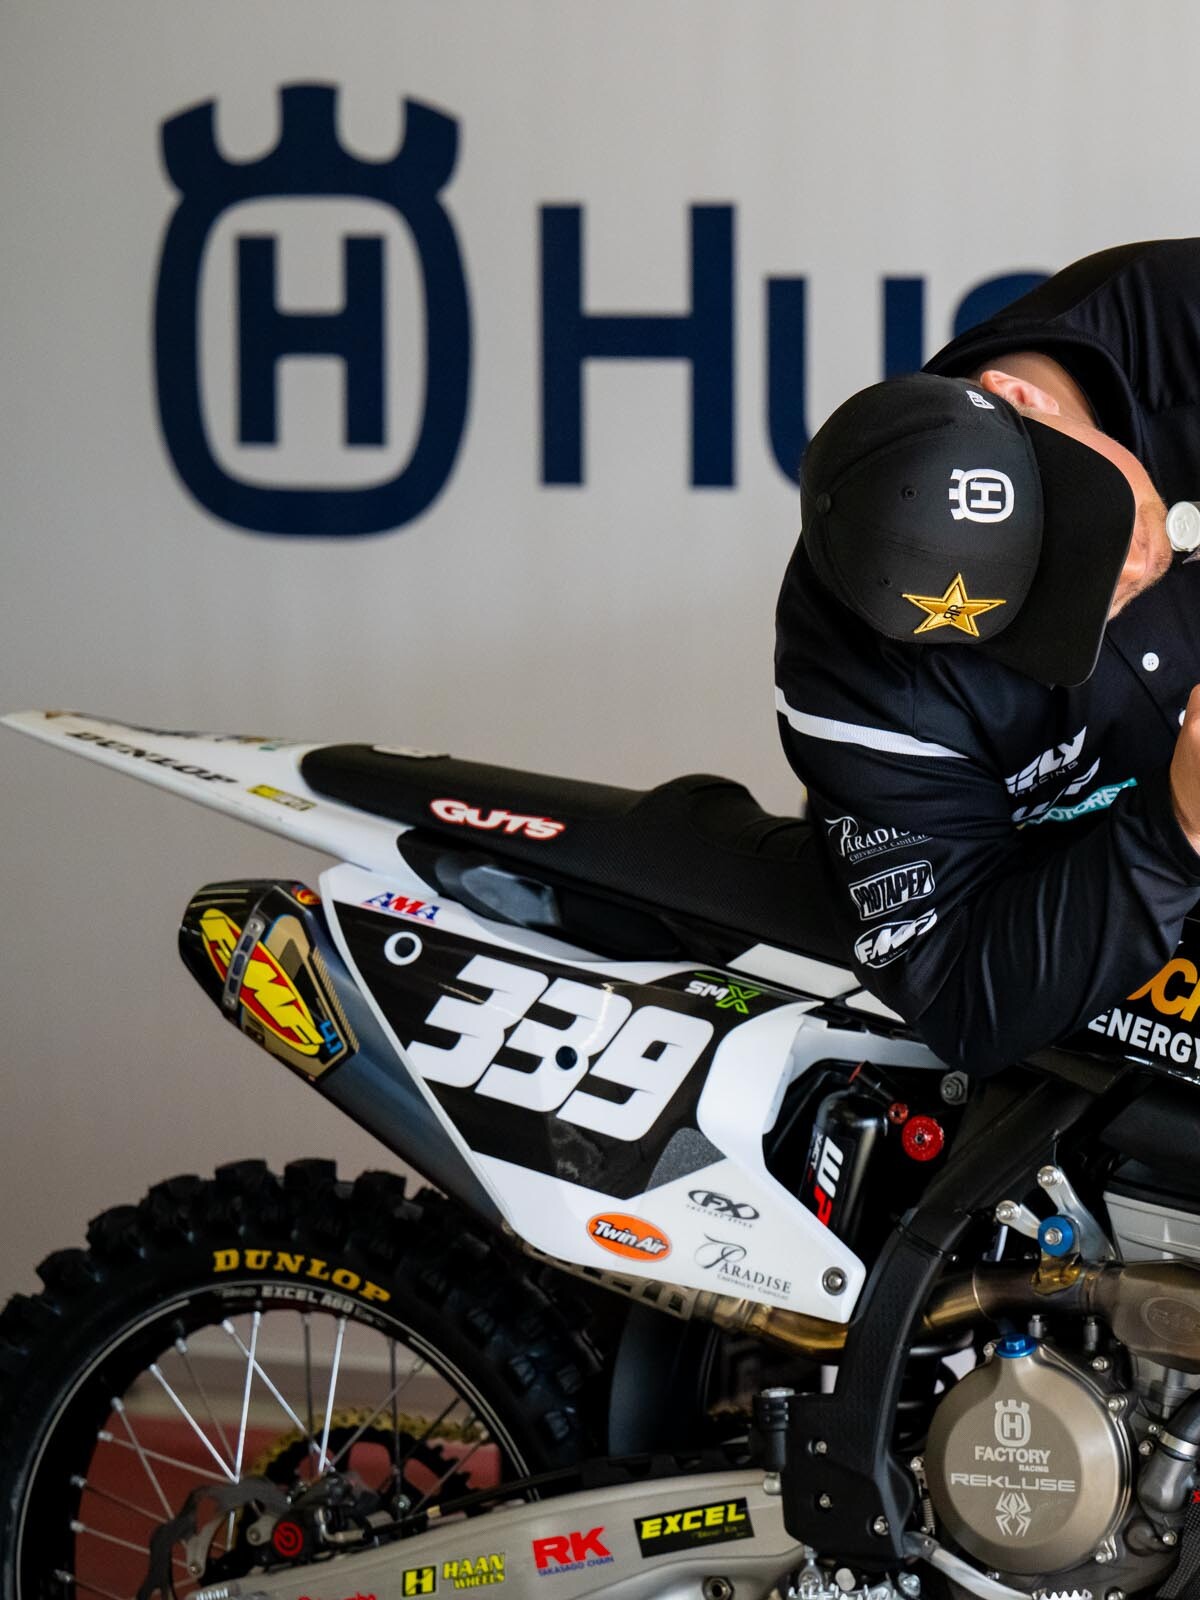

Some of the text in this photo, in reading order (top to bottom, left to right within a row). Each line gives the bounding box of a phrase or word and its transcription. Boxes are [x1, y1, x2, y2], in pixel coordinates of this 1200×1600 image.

[429, 798, 567, 840] GUTS
[364, 891, 441, 922] AMA
[403, 953, 715, 1143] 339
[592, 1218, 669, 1257] Twin Air
[212, 1248, 392, 1303] DUNLOP
[261, 1285, 319, 1304] EXCEL
[974, 1445, 1052, 1466] FACTORY
[1018, 1464, 1050, 1473] RACING
[950, 1472, 1077, 1493] REKLUSE
[640, 1502, 747, 1541] EXCEL
[532, 1525, 612, 1571] RK
[442, 1554, 506, 1580] HAAN
